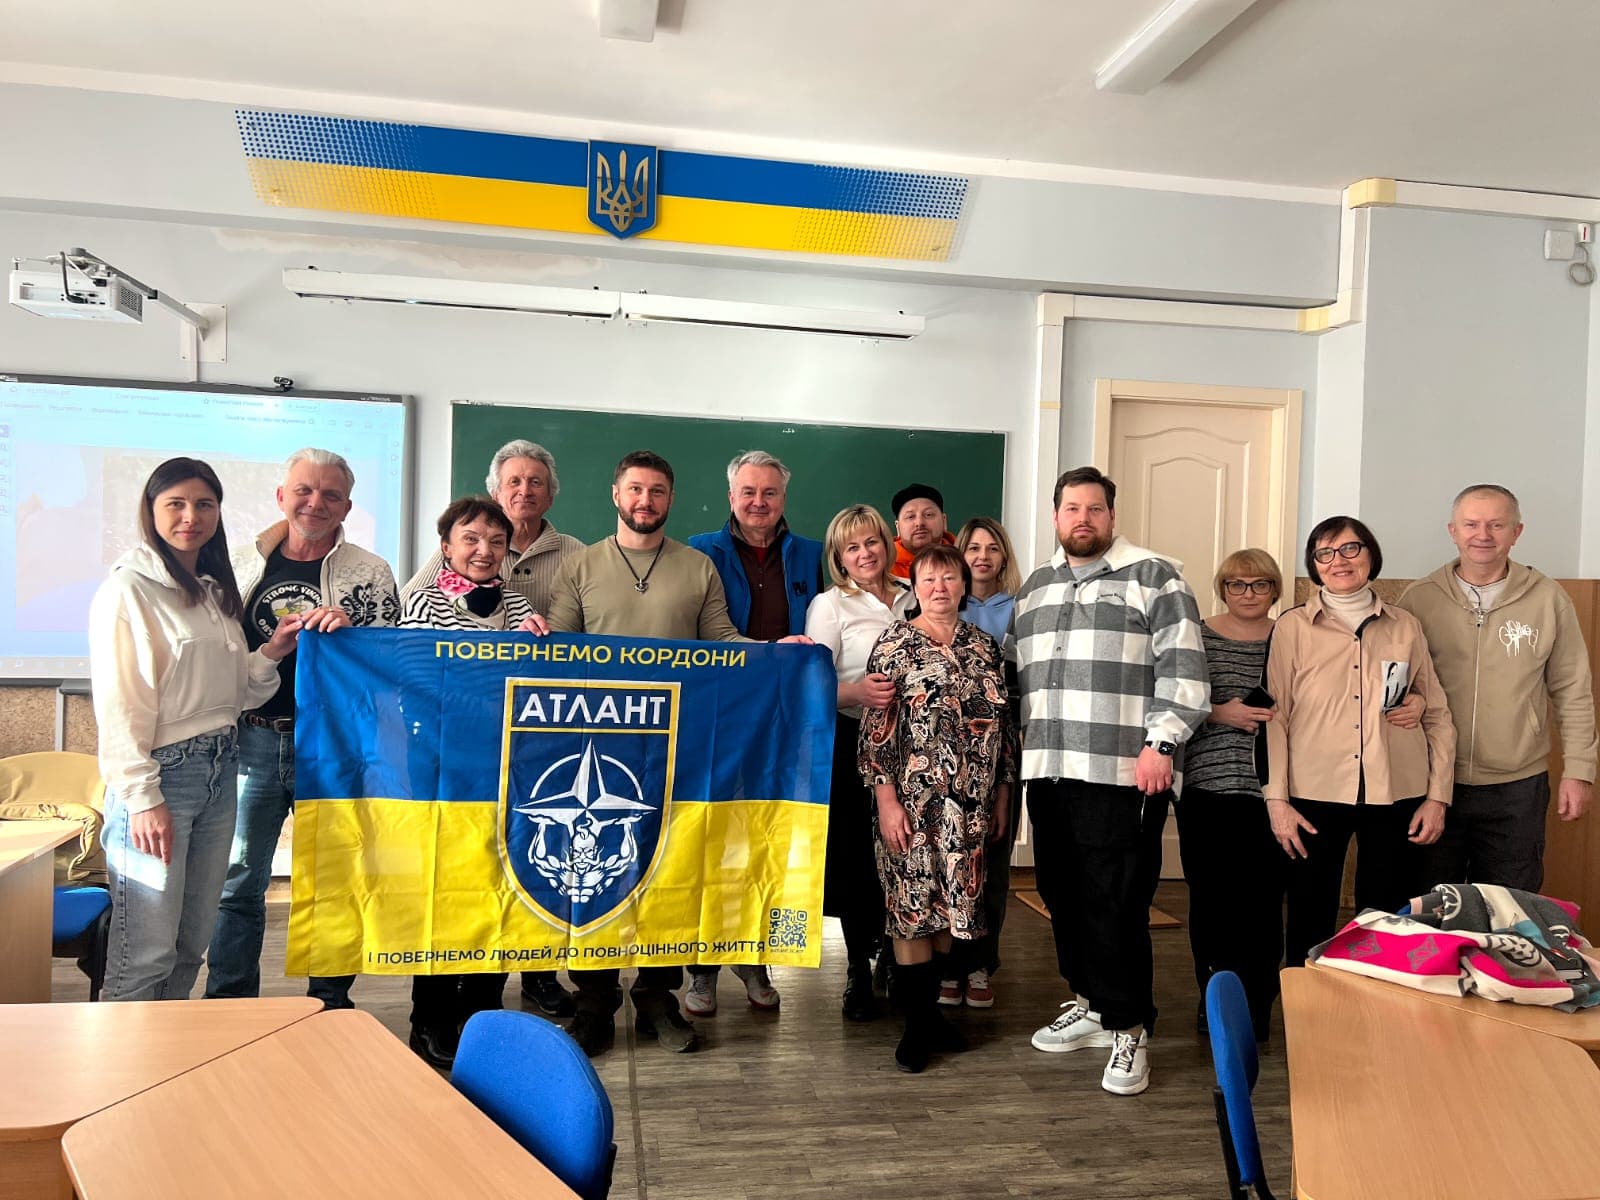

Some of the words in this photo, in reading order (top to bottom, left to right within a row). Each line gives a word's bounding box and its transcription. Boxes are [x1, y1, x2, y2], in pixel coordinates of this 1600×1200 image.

[262, 584, 299, 604] STRONG
[435, 641, 612, 664] ПОВЕРНЕМО
[620, 647, 746, 669] КОРДОНИ
[517, 692, 666, 725] АТЛАНТ
[368, 951, 372, 963] І
[377, 949, 486, 964] ПОВЕРНЕМО
[490, 945, 552, 961] ЛЮДЕЙ
[556, 947, 578, 961] ДО
[583, 942, 708, 958] ПОВНОЦІННОГО
[712, 941, 765, 953] ЖИТТЯ
